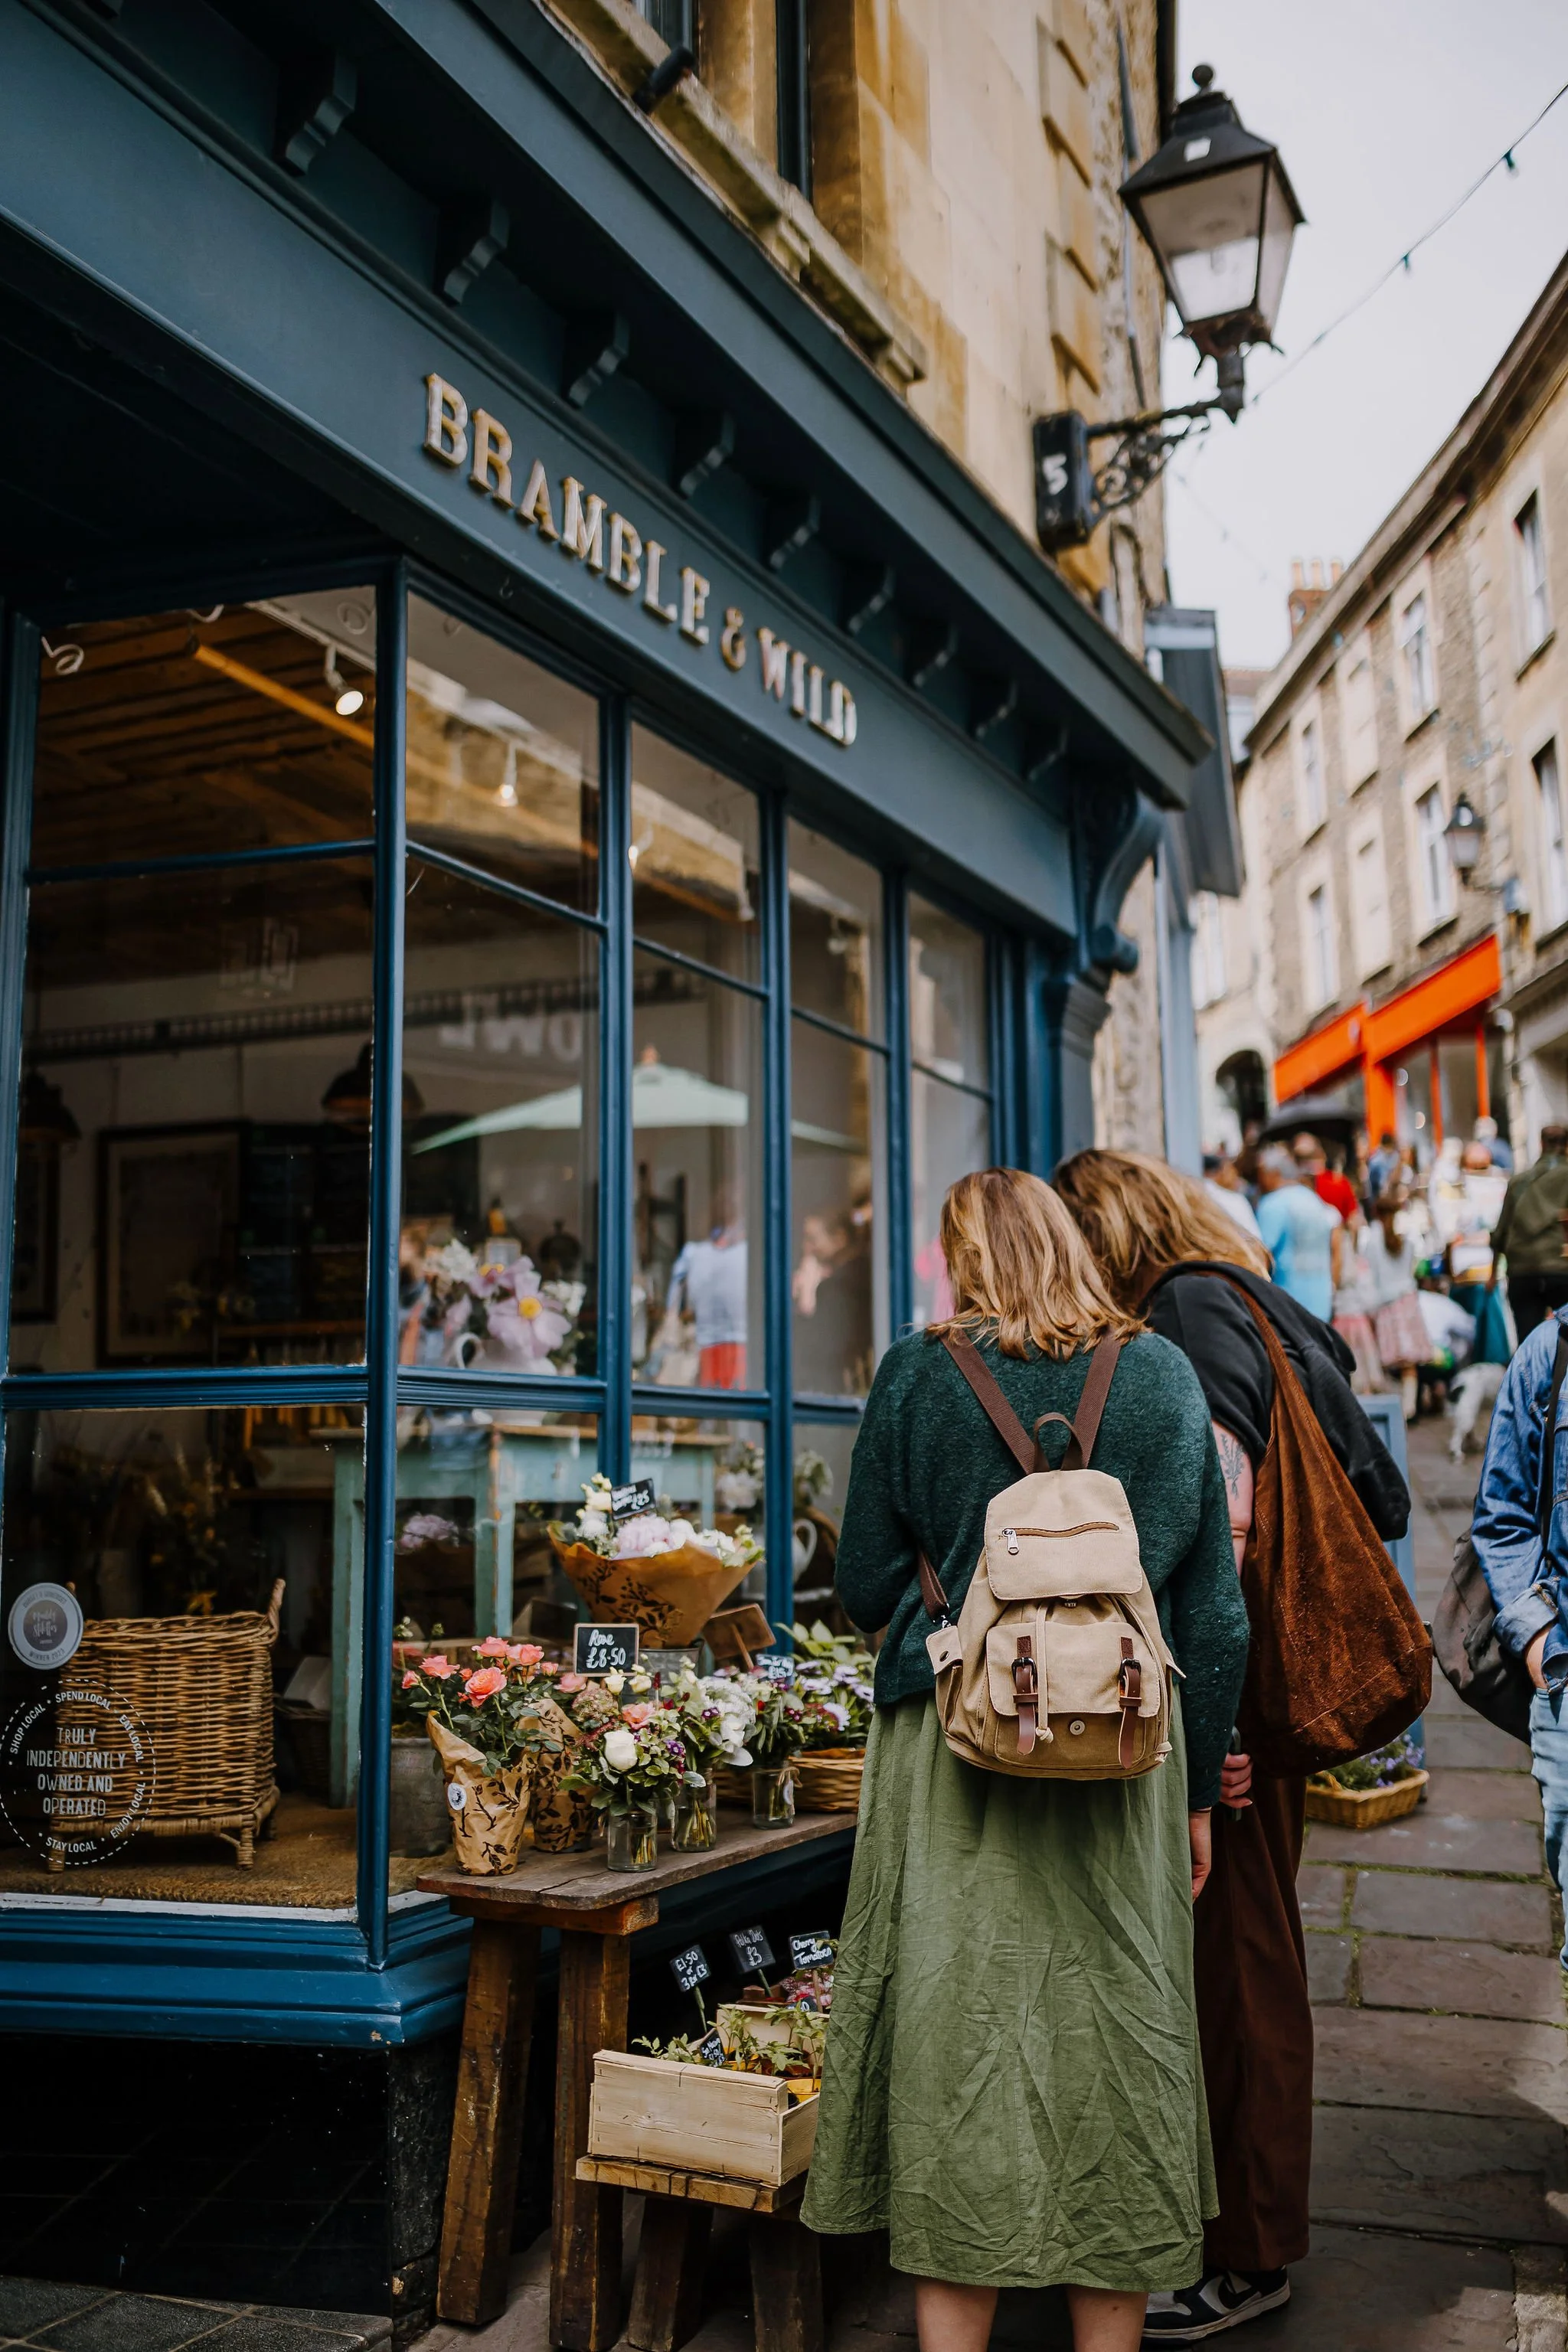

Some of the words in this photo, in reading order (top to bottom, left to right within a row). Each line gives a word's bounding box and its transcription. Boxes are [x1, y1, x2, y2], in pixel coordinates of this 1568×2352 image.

[1042, 453, 1069, 495] 5
[424, 372, 710, 645] BRAMBLE
[721, 607, 746, 671] &
[757, 626, 858, 746] WILD
[588, 1628, 615, 1646] Rose
[586, 1647, 626, 1668] £8.50
[55, 1690, 84, 1704] SPEND
[85, 1692, 112, 1710] LOCAL
[10, 1728, 24, 1754] SHOP
[21, 1704, 46, 1730] LOCAL
[57, 1727, 96, 1745] TRULY
[119, 1714, 134, 1732] EAT
[129, 1730, 144, 1762] LOCAL
[27, 1749, 126, 1769] INDEPENDENTLY
[38, 1773, 83, 1792] OWNED
[87, 1775, 113, 1792] AND
[43, 1797, 106, 1816] OPERATED
[109, 1811, 133, 1838] ENJOY
[129, 1782, 145, 1815] LOCAL
[45, 1837, 68, 1851] STAY
[68, 1841, 97, 1853] LOCAL
[734, 1933, 752, 1948] Polka
[792, 1938, 818, 1953] Cherry
[675, 1951, 698, 1972] £1.50
[746, 1946, 763, 1966] £3
[793, 1946, 832, 1965] Tomatoes
[681, 1977, 691, 1990] 3
